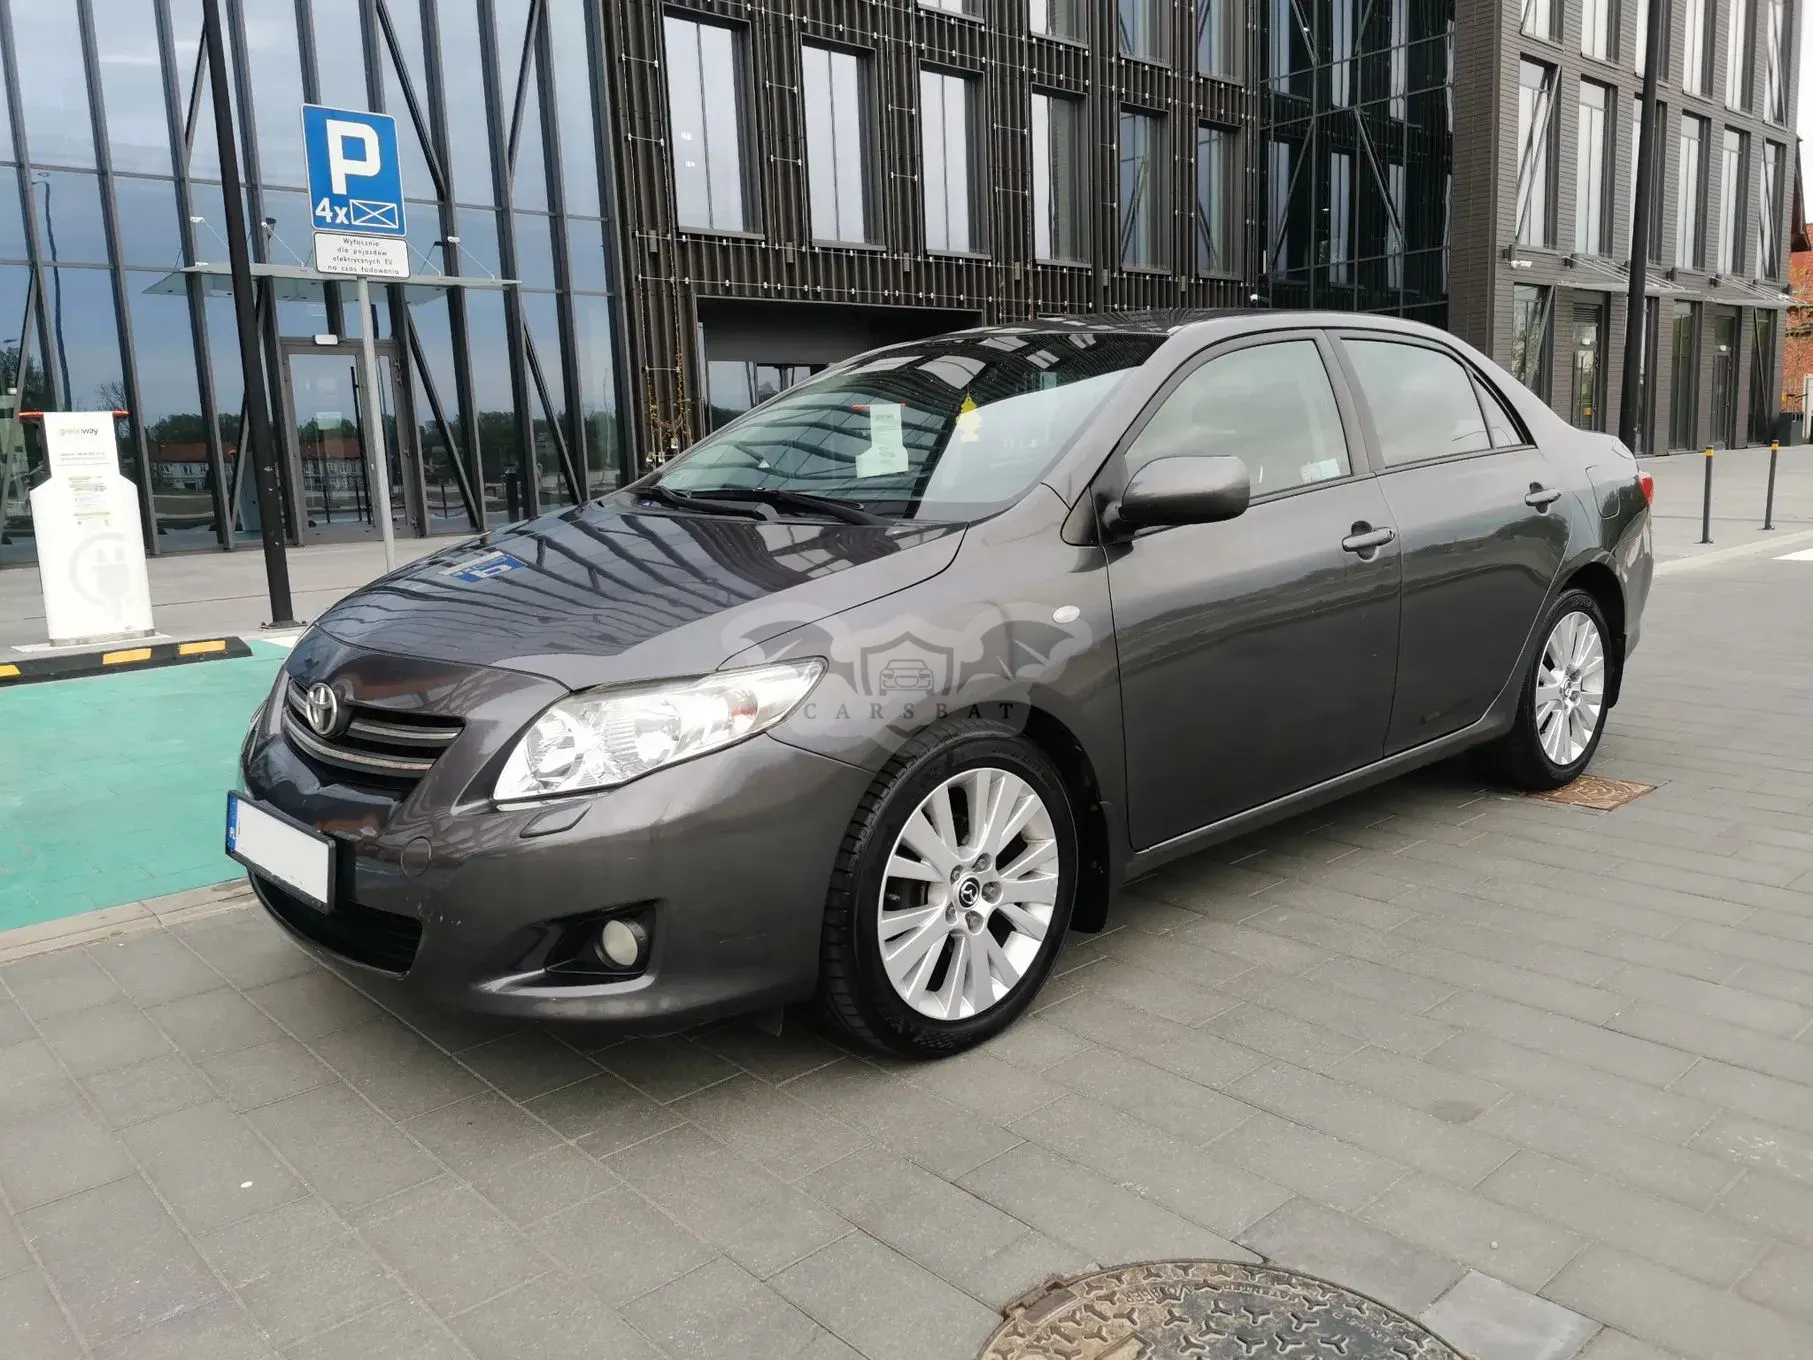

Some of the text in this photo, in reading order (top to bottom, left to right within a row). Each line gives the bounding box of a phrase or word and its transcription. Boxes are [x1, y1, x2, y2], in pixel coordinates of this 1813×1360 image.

[326, 119, 381, 195] P
[315, 197, 350, 225] 4x
[332, 255, 381, 266] elektrycznych
[360, 266, 400, 275] ładowania
